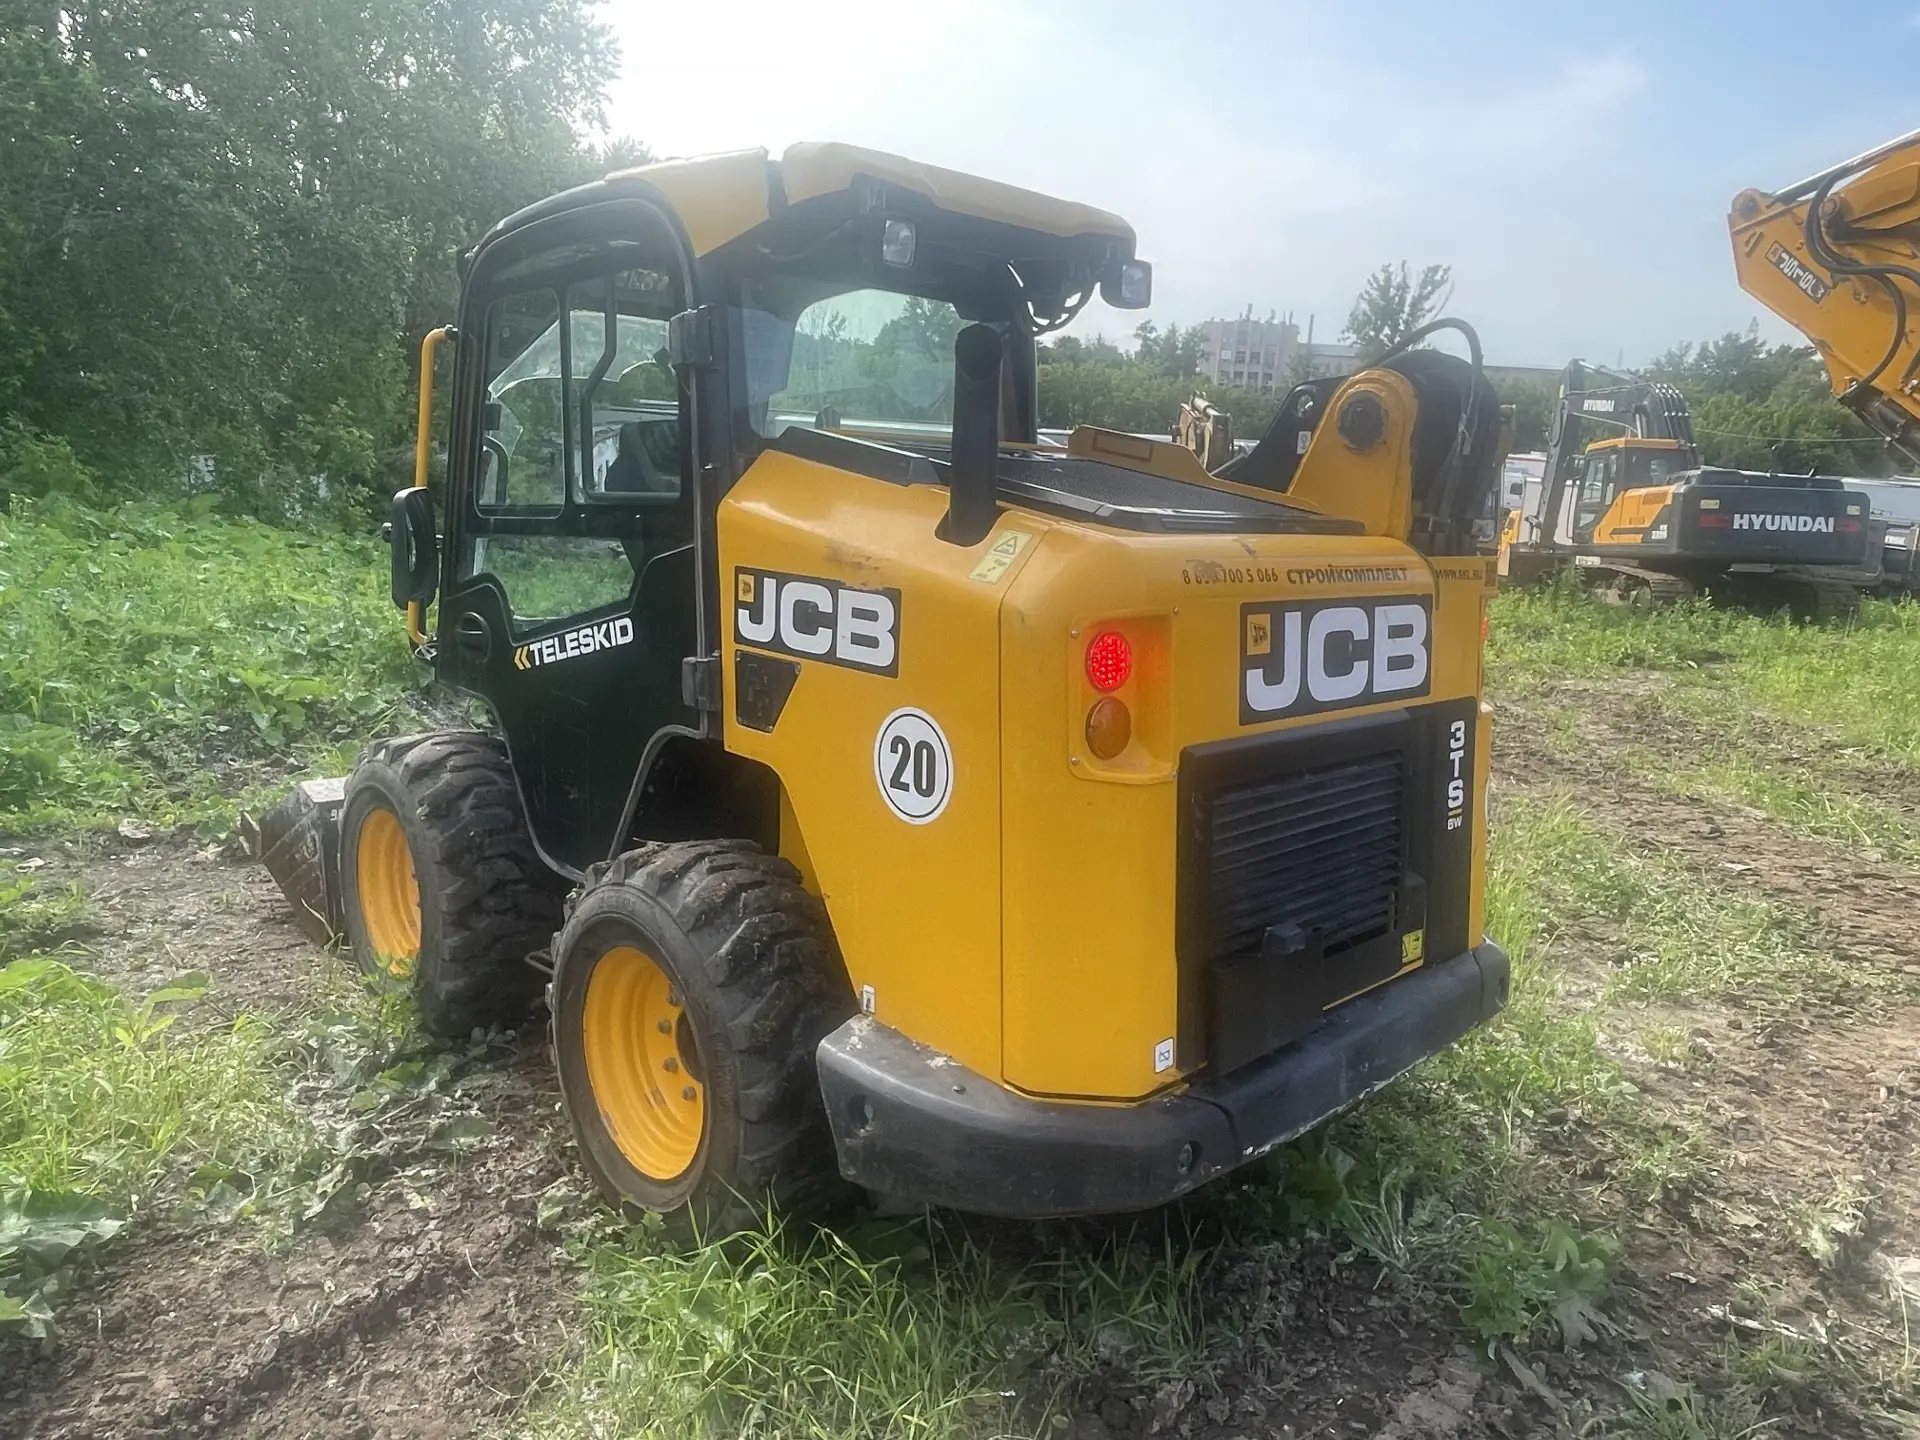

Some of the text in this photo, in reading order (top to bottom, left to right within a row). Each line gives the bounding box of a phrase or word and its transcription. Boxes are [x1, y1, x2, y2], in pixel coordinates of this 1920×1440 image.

[1732, 513, 1835, 533] HYUNDAI
[1286, 563, 1408, 585] СТРОЙКОМПЛЕКТ
[529, 616, 635, 667] TELESKID
[737, 576, 896, 668] JCB
[1245, 603, 1428, 711] JCB
[888, 733, 937, 799] 20
